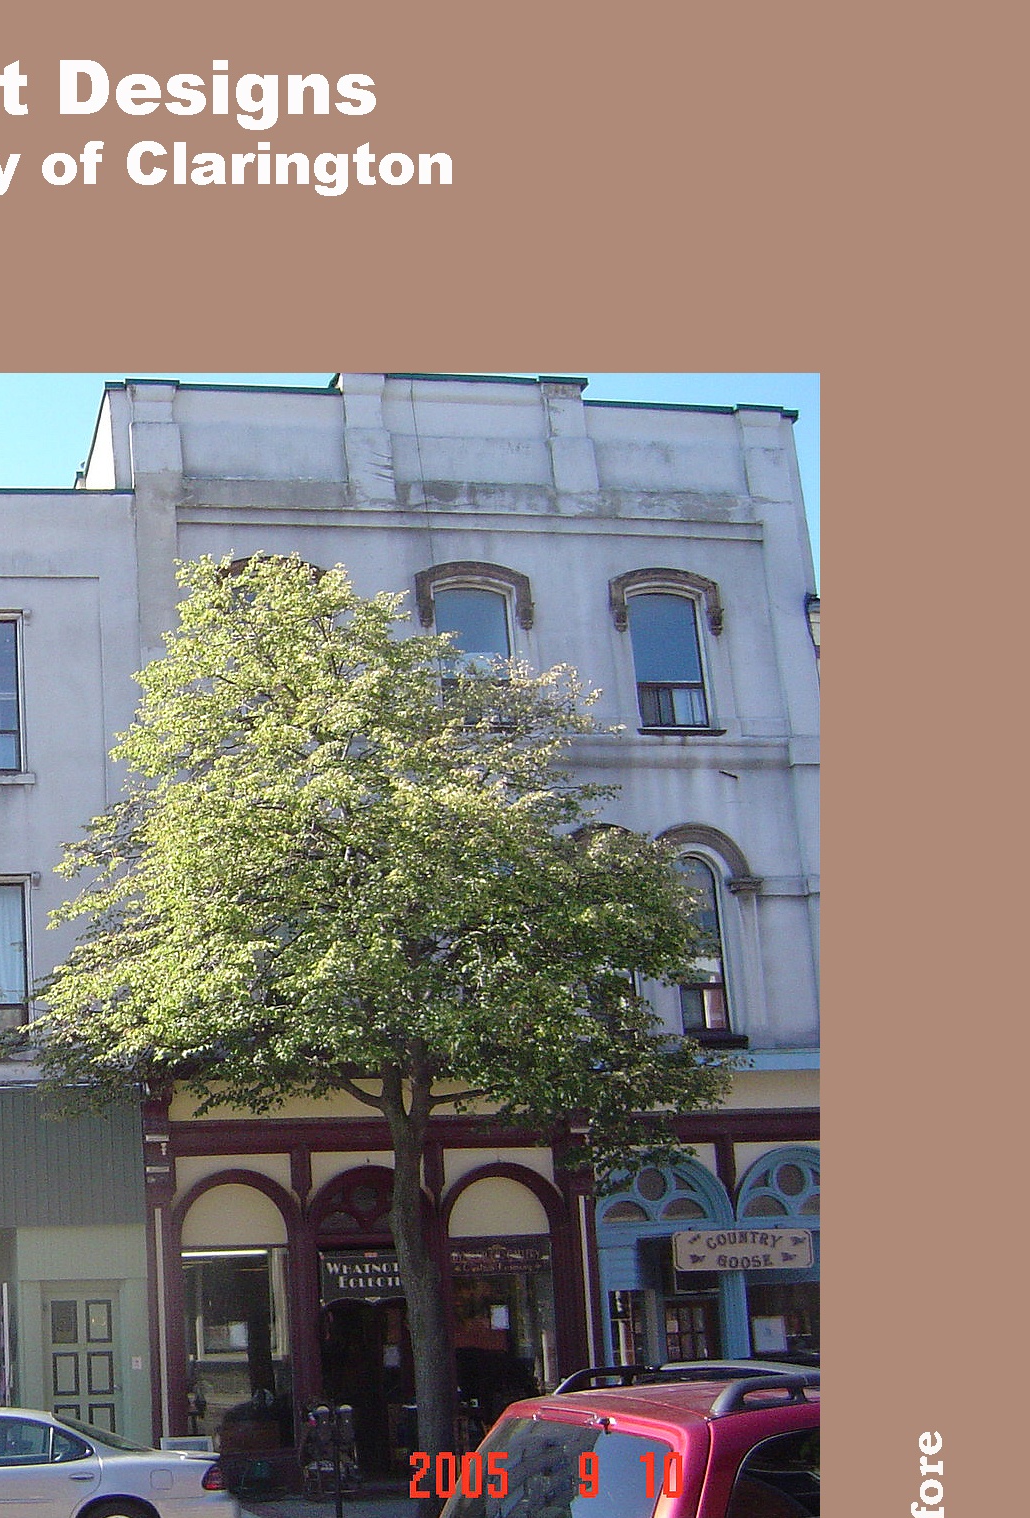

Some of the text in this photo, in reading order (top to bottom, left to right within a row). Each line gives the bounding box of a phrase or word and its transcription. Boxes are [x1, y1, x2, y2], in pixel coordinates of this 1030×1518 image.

[706, 1231, 782, 1250] COUNTRY
[717, 1253, 774, 1268] GOOSE
[326, 1262, 399, 1274] WHATNOT
[338, 1276, 401, 1288] ECLECTI
